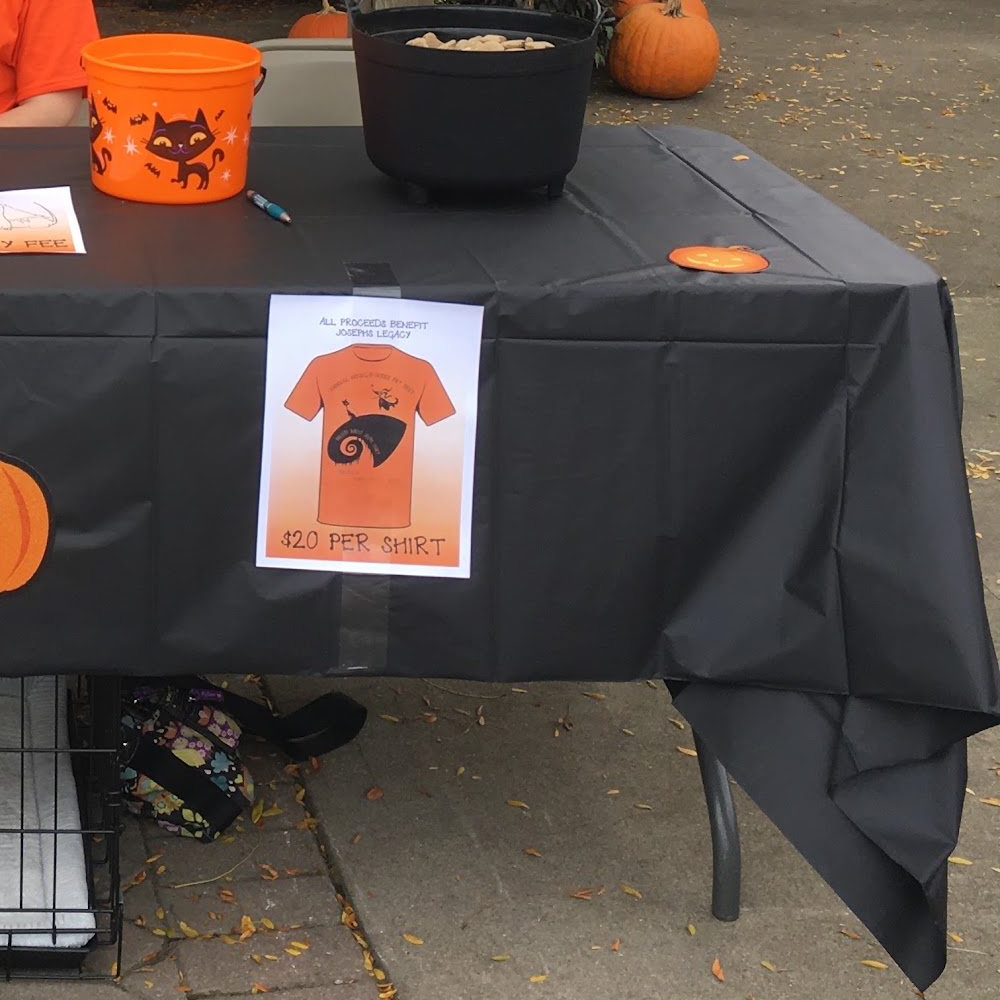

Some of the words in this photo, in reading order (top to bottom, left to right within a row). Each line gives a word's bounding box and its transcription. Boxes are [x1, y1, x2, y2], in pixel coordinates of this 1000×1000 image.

[24, 238, 69, 248] FEE
[319, 316, 336, 326] ALL
[339, 318, 387, 328] PROCEEDS
[390, 320, 429, 330] BENEFIT
[335, 328, 374, 338] JOSEPHS
[376, 330, 412, 340] LEGACY
[281, 530, 319, 550] $20
[329, 532, 370, 552] PER
[381, 535, 447, 556] SHIRT
